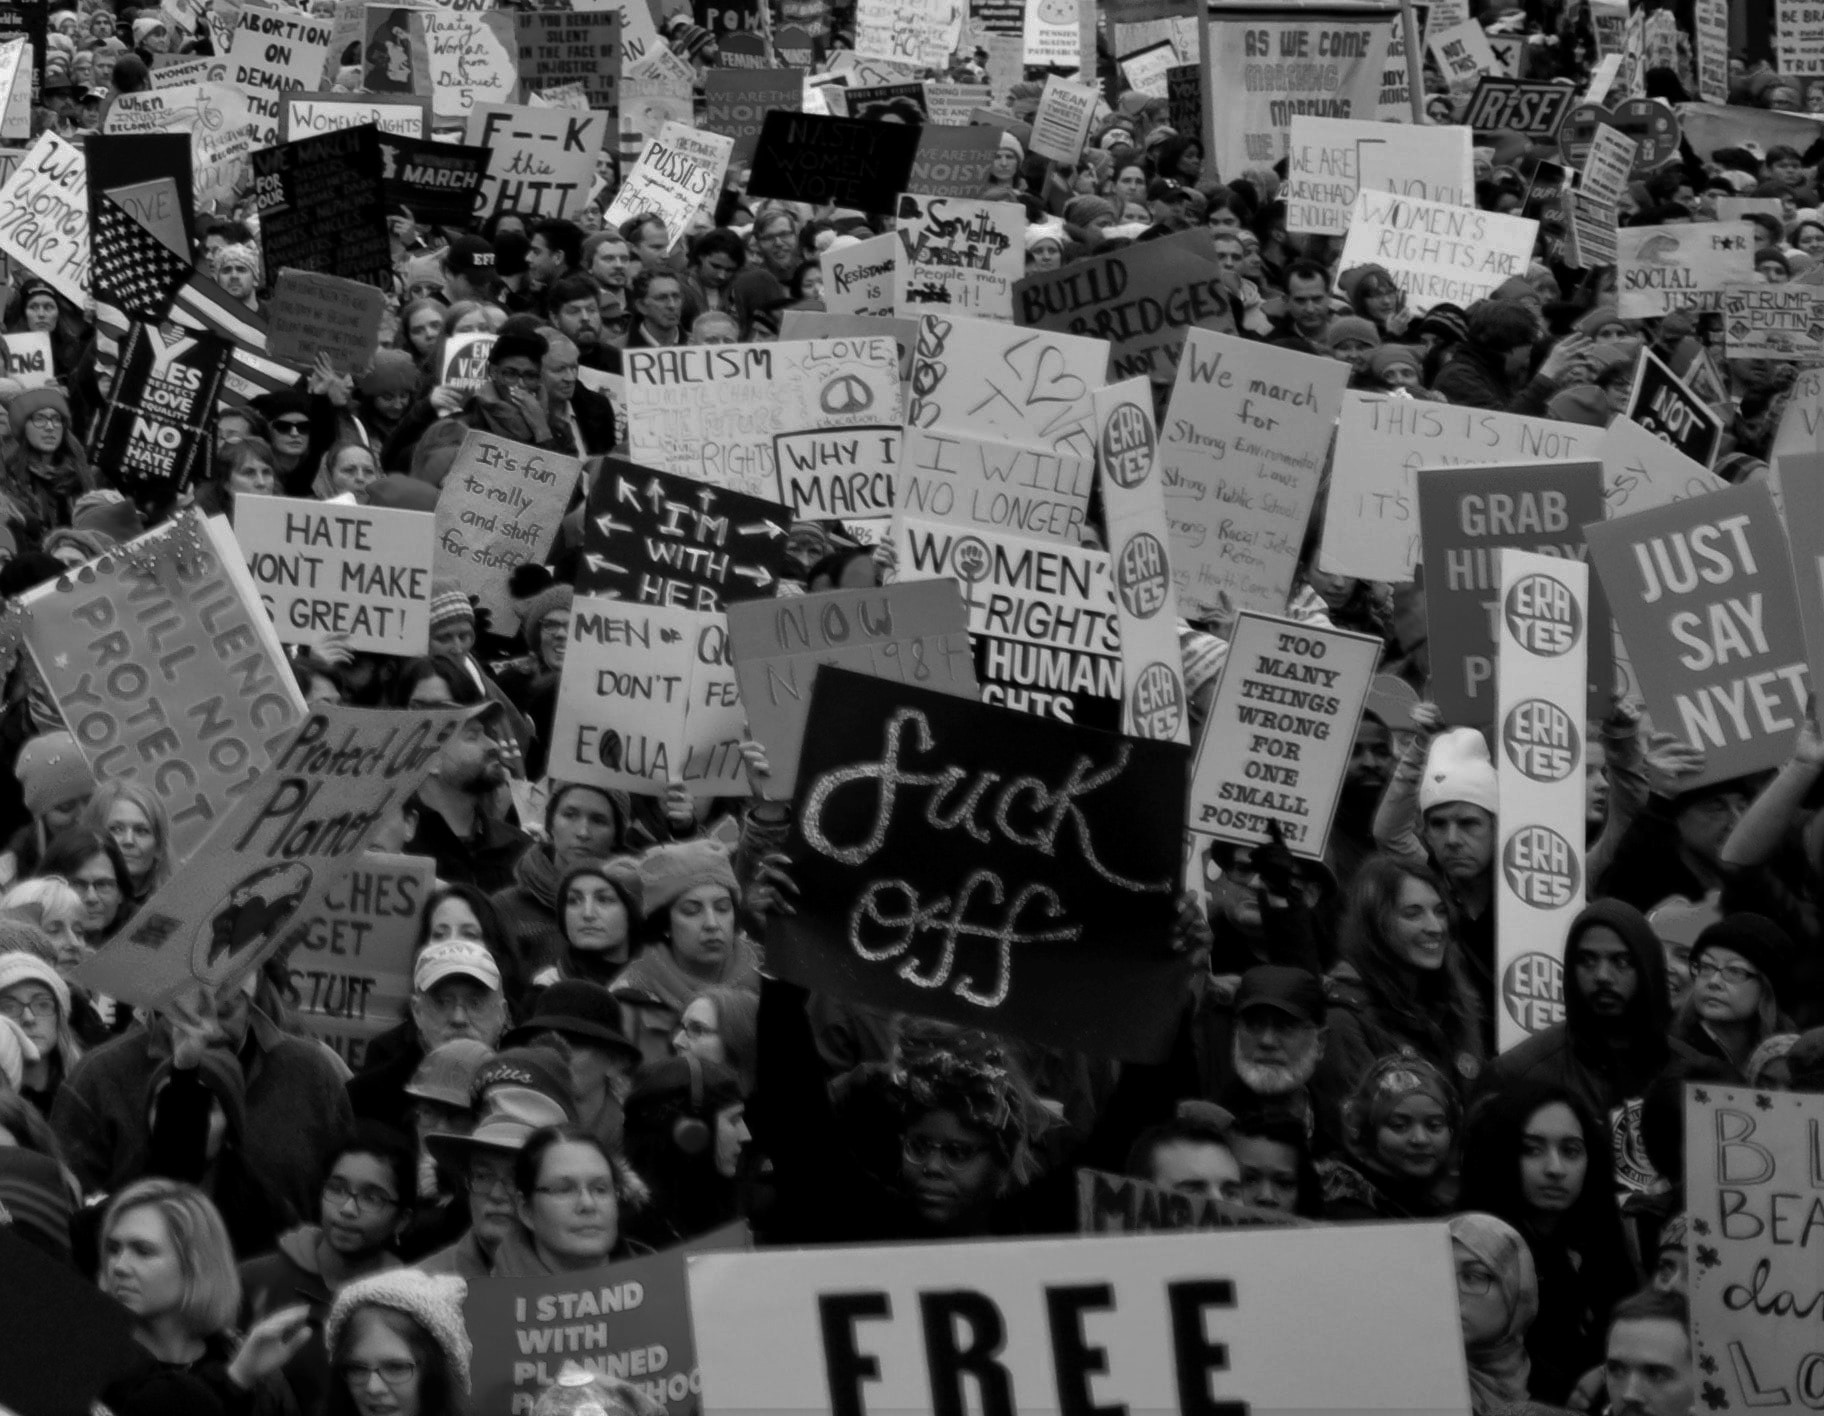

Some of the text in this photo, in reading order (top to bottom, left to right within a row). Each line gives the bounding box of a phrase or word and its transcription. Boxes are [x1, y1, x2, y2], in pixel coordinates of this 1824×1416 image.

[236, 11, 331, 47] ABORTION
[546, 30, 588, 42] SILENT
[265, 44, 291, 64] ON
[537, 61, 598, 73] INJUSTICE
[629, 350, 772, 385] RACISM
[1360, 398, 1579, 460] THIS IS NOT
[286, 512, 373, 551] HATE
[1459, 491, 1569, 537] GRAB
[1631, 514, 1759, 604] JUST
[340, 559, 427, 601] MAKE
[289, 599, 407, 640] GREAT!
[1512, 579, 1573, 624] ERA
[1276, 634, 1327, 659] TOO
[1510, 616, 1574, 654] YES
[1669, 593, 1771, 672] SAY
[1255, 655, 1340, 689] MANY
[1242, 680, 1341, 716] THINGS
[1672, 663, 1810, 751] NYET
[1236, 704, 1332, 741] WRONG
[1249, 734, 1302, 762] FOR
[1219, 783, 1311, 818] SMALL
[516, 1281, 644, 1324] I STAND
[515, 1324, 608, 1355] WITH
[814, 1280, 1250, 1416] FREE
